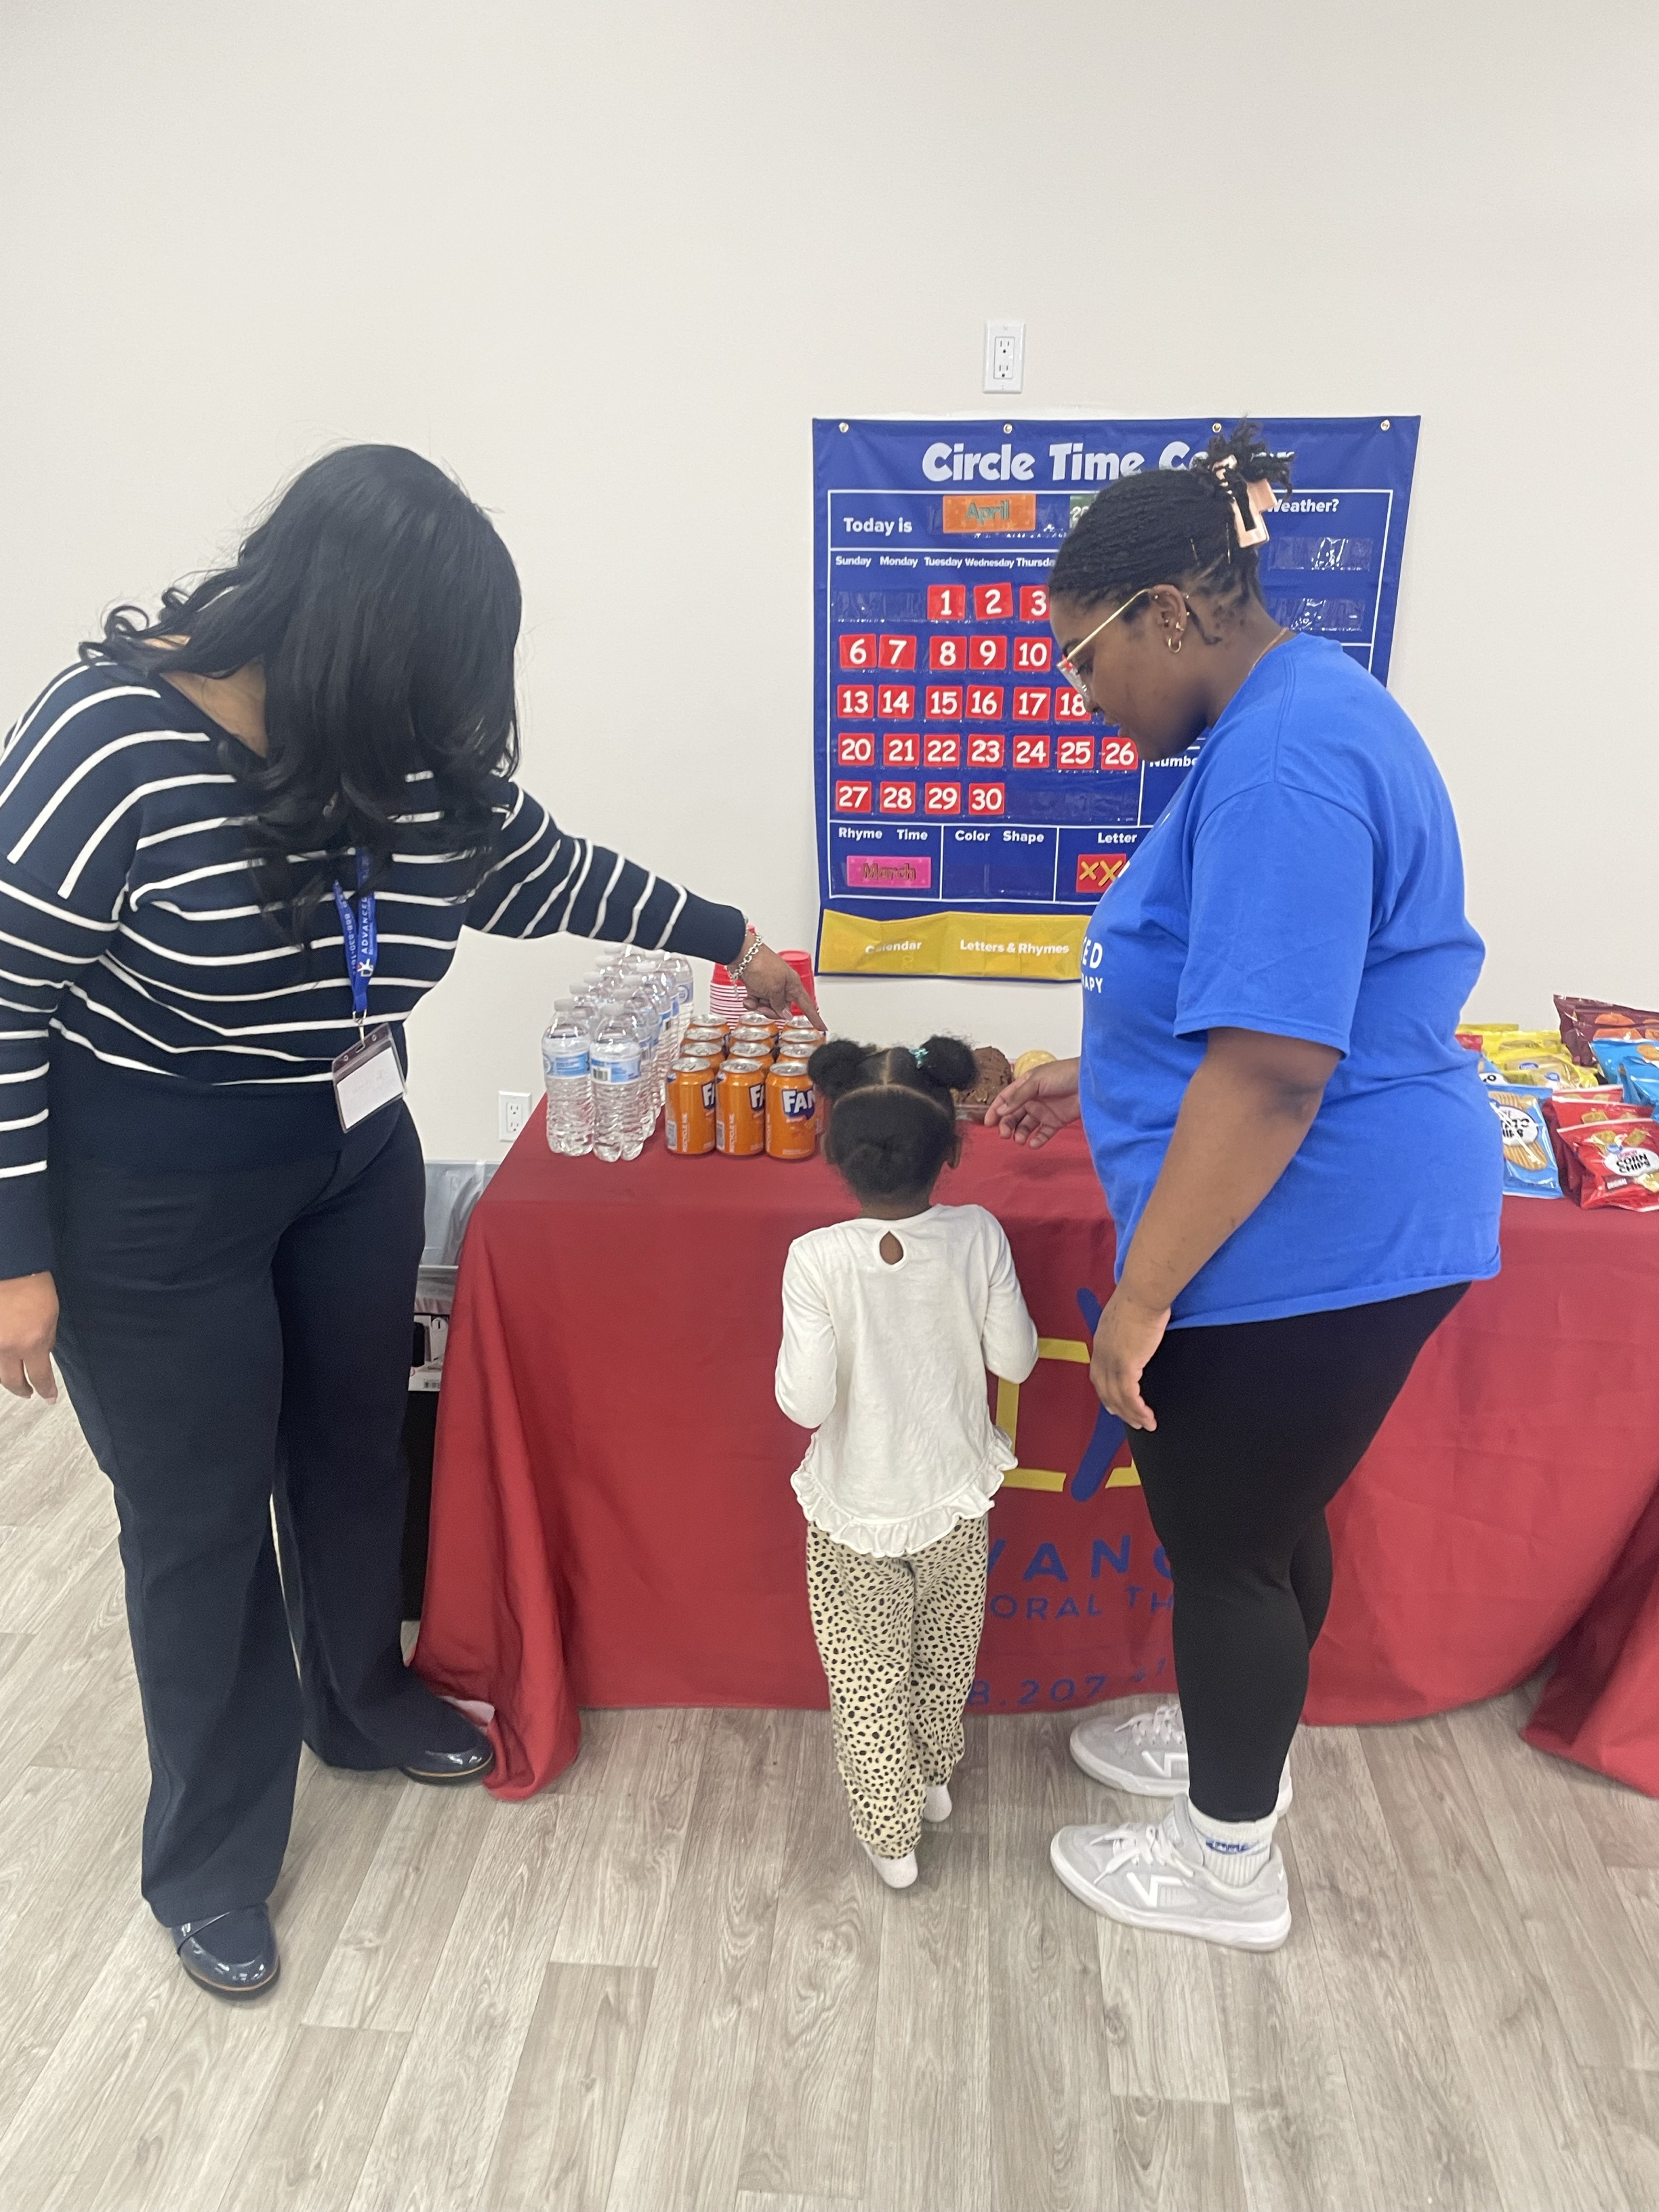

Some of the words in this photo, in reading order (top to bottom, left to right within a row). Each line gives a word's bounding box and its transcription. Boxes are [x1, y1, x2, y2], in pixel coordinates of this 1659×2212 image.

[922, 443, 1035, 482] Circle
[1050, 443, 1145, 480] Time
[966, 500, 1009, 525] April
[843, 517, 893, 534] Today
[899, 516, 912, 533] is
[836, 556, 872, 567] Sunday
[880, 556, 918, 568] Monday
[924, 557, 962, 569] Tuesday
[965, 558, 1015, 569] Wednesday
[1017, 558, 1054, 567] Thursda
[941, 590, 951, 615] 1
[985, 590, 1002, 614] 2
[1031, 591, 1046, 615] 3
[850, 639, 866, 664] 6
[889, 640, 907, 664] 7
[940, 642, 956, 665] 8
[980, 640, 996, 665] 9
[1019, 643, 1047, 666] 10
[843, 691, 868, 713] 13
[883, 691, 909, 714] 14
[931, 691, 957, 714] 15
[972, 691, 997, 714] 16
[1019, 693, 1046, 715] 17
[1061, 693, 1086, 716] 18
[842, 739, 871, 760] 20
[889, 739, 914, 761] 21
[928, 740, 956, 762] 22
[972, 740, 999, 762] 23
[1017, 741, 1046, 763] 24
[1061, 742, 1090, 764] 25
[1105, 743, 1134, 765] 26
[840, 786, 868, 807] 27
[884, 787, 912, 808] 28
[929, 788, 957, 809] 29
[972, 789, 1002, 810] 30
[838, 827, 883, 840] Rhyme
[897, 829, 928, 840] Time
[955, 830, 990, 841] Color
[1003, 830, 1044, 844] Shape
[1097, 832, 1137, 843] Letter
[863, 862, 916, 880] March
[960, 939, 1004, 953] Letters
[1006, 942, 1016, 954] &
[1019, 943, 1069, 955] Rhymes
[1616, 1153, 1647, 1167] CORN
